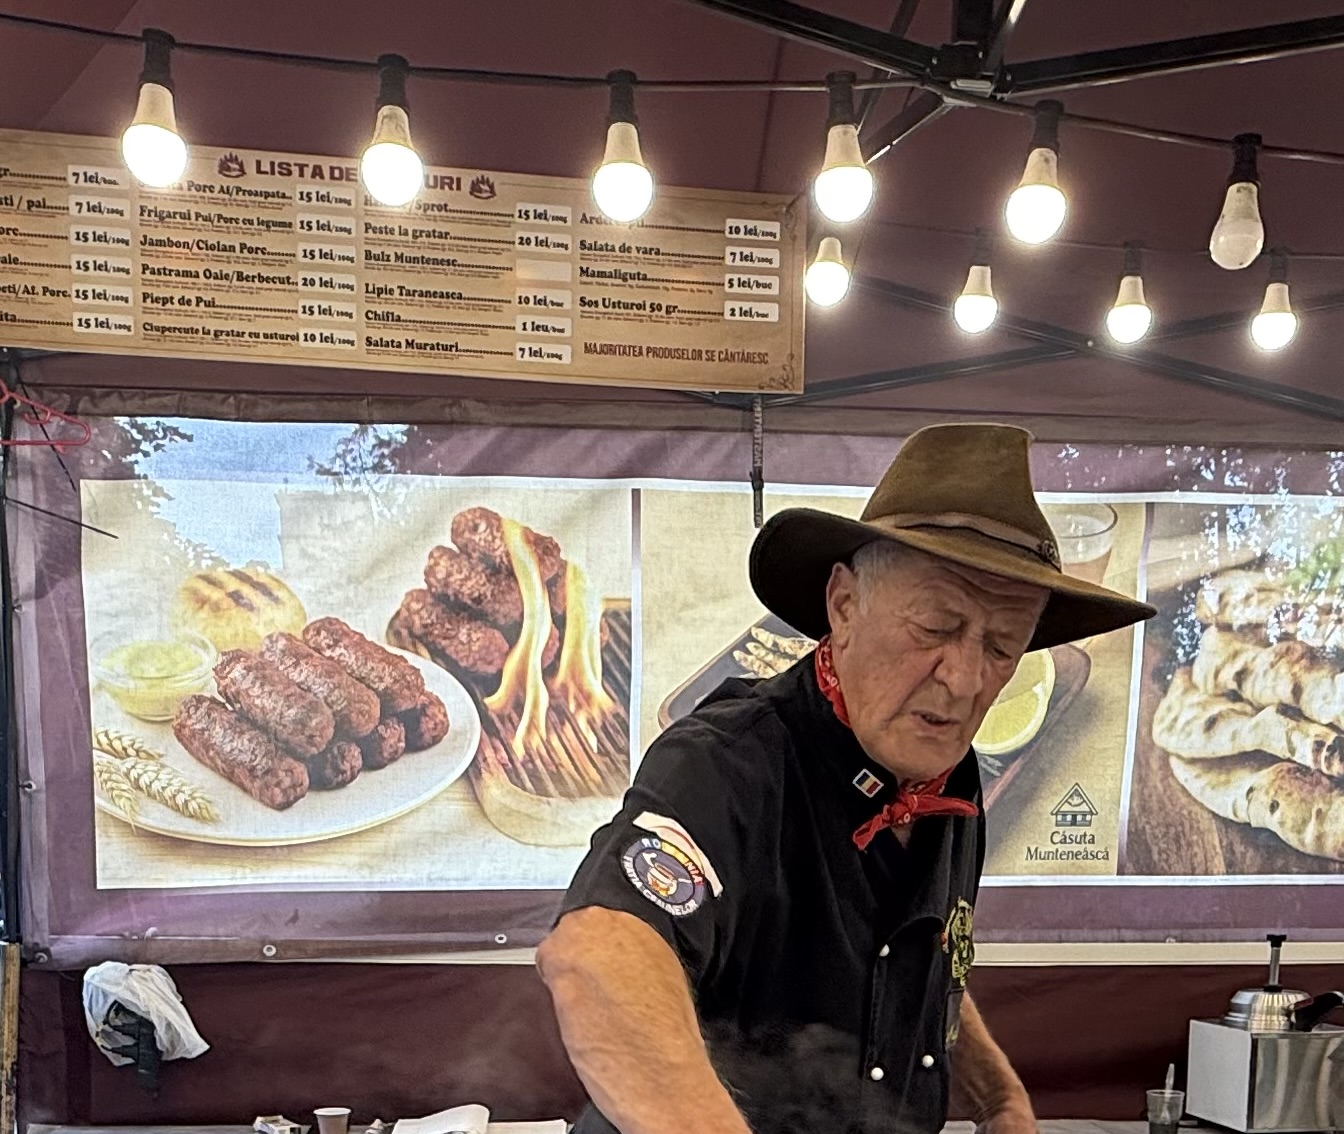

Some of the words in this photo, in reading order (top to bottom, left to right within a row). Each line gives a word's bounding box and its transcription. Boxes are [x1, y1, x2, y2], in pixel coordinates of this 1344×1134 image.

[72, 171, 80, 185] 7
[255, 159, 325, 180] LISTA
[329, 166, 358, 183] DE
[187, 180, 215, 194] Porc
[298, 190, 312, 203] 15
[75, 201, 83, 214] 7
[139, 205, 191, 221] Frigarui
[194, 211, 240, 226] Pui/Porc
[242, 216, 255, 227] cu
[256, 217, 293, 231] legume
[299, 220, 312, 231] 15
[517, 208, 530, 220] 15
[74, 231, 89, 243] 15
[364, 222, 395, 236] Peste
[398, 224, 409, 236] la
[518, 236, 532, 247] 20
[728, 225, 741, 235] 10
[139, 235, 236, 253] Jambon/Ciolan
[302, 248, 316, 260] 15
[364, 250, 391, 263] Bulz
[579, 239, 616, 253] Salata
[618, 242, 632, 254] de
[729, 251, 736, 263] 7
[75, 259, 89, 272] 15
[141, 264, 200, 280] Pastrama
[301, 277, 316, 287] 20
[364, 283, 395, 298] Lipie
[517, 295, 531, 305] 10
[727, 278, 734, 288] 5
[737, 277, 772, 290] lei/buc
[74, 288, 88, 301] 15
[142, 292, 175, 307] Piept
[178, 295, 192, 307] de
[301, 304, 315, 316] 15
[579, 296, 599, 308] Sos
[602, 298, 647, 311] Usturoi
[649, 302, 662, 312] 50
[729, 307, 736, 317] 2
[77, 317, 91, 329] 15
[142, 322, 200, 337] Ciupercute
[201, 325, 211, 336] la
[213, 327, 246, 340] gratar
[248, 330, 260, 340] cu
[262, 331, 299, 342] usturoi
[303, 332, 316, 343] 10
[522, 321, 528, 332] 1
[364, 336, 402, 350] Salata
[518, 347, 526, 359] 7
[583, 341, 643, 357] MAJORITATEA
[646, 346, 703, 362] PRODUSELOR
[705, 350, 716, 362] SE
